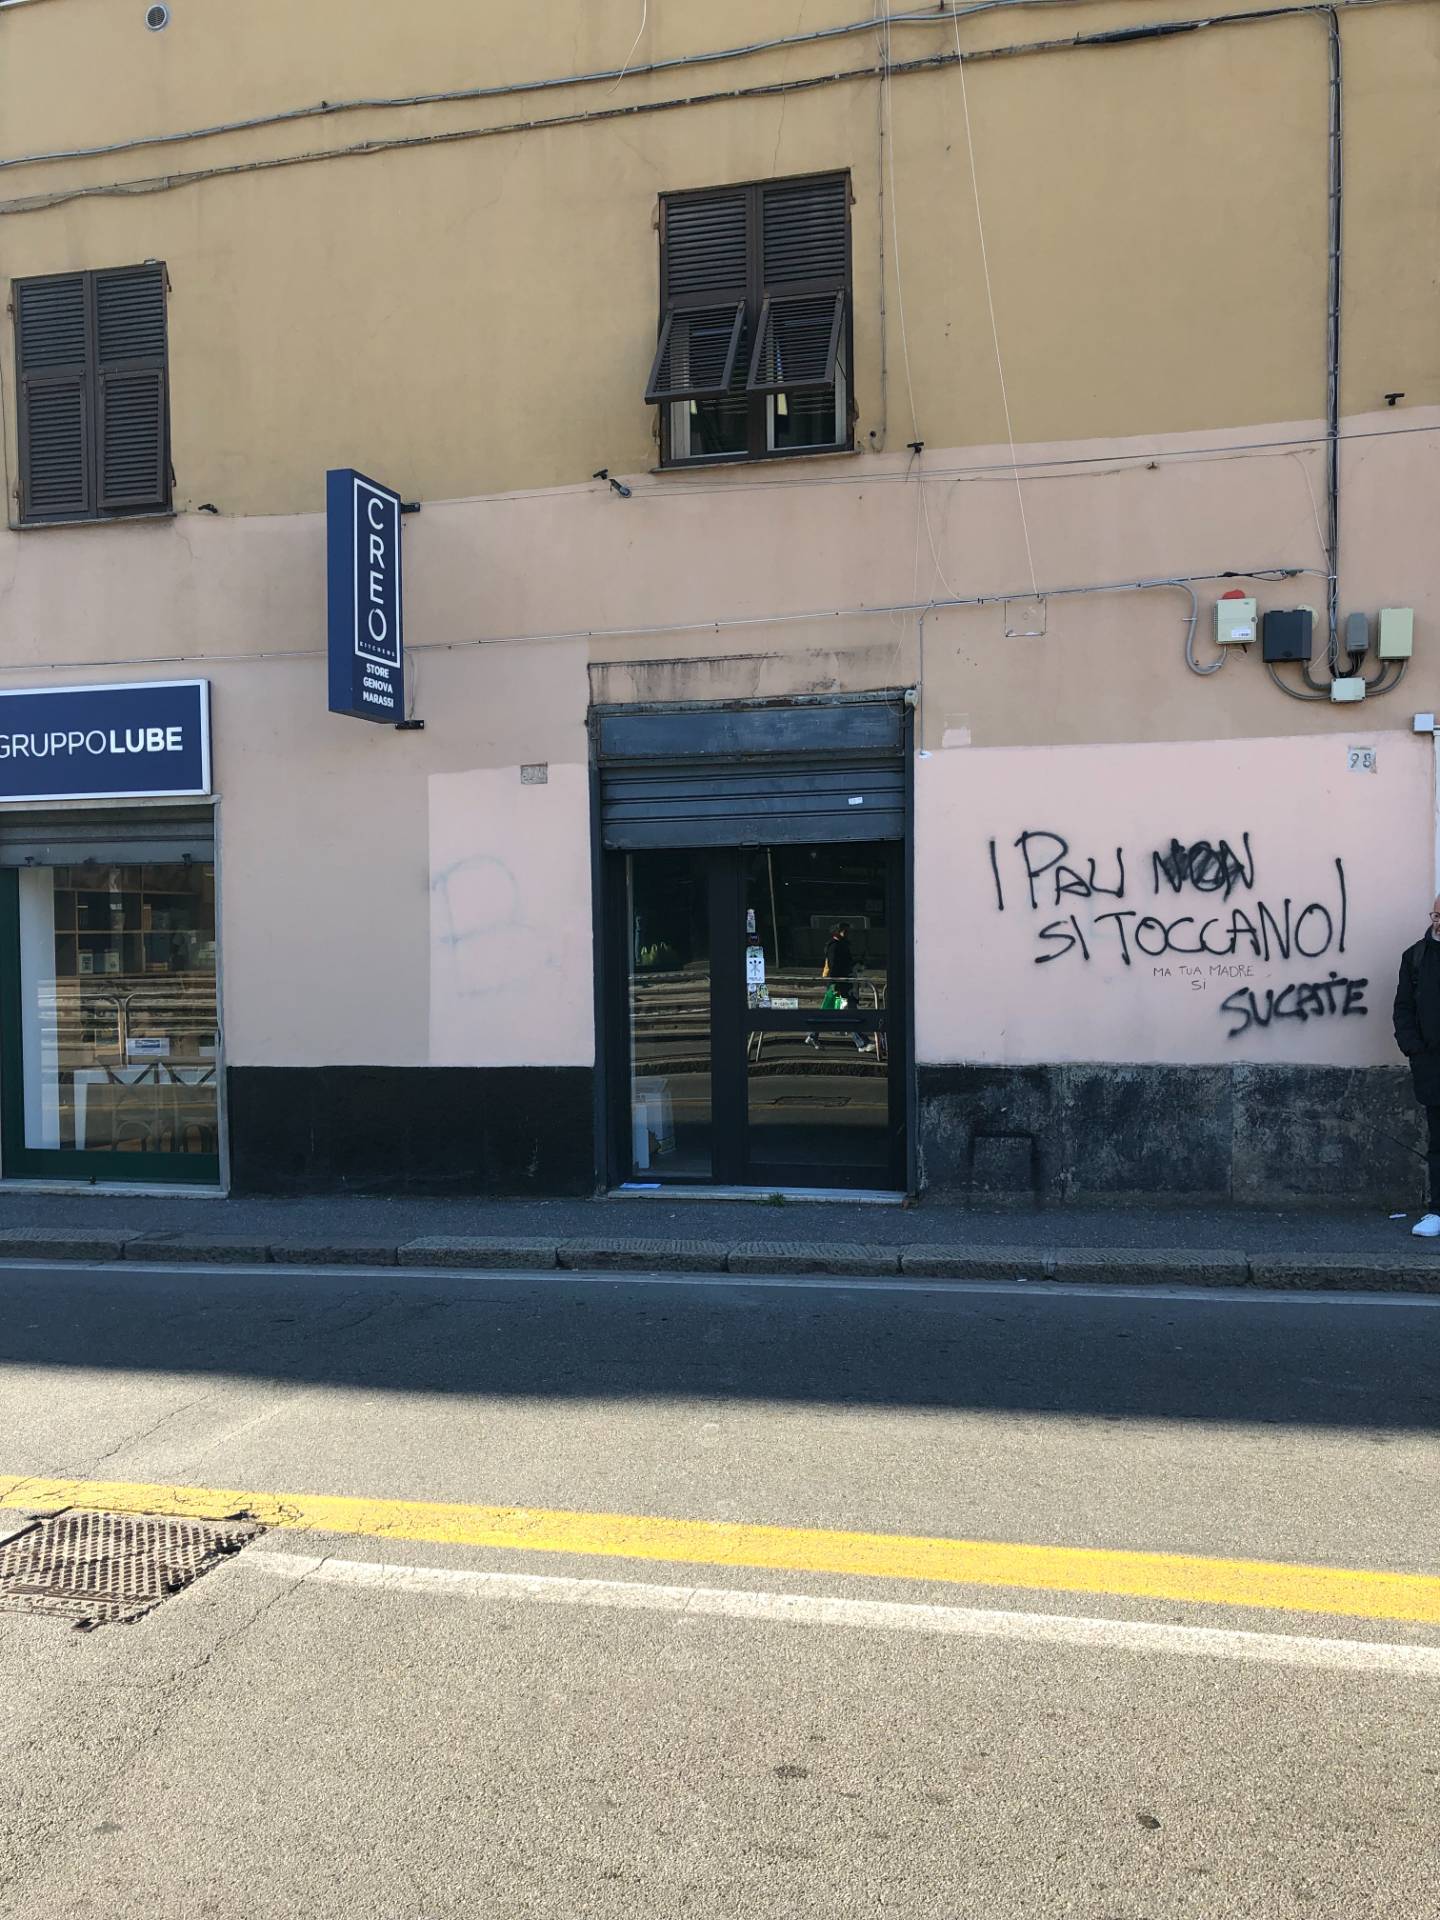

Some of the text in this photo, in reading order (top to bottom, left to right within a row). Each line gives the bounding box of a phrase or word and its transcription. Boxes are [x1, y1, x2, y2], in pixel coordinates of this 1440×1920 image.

[367, 497, 387, 641] CREO
[366, 663, 390, 679] STORE
[363, 676, 393, 693] GENOVA
[362, 690, 394, 708] MARASSI
[1034, 914, 1090, 964] SI
[1153, 964, 1254, 977] MA TUA MADRE
[1191, 980, 1206, 991] SI
